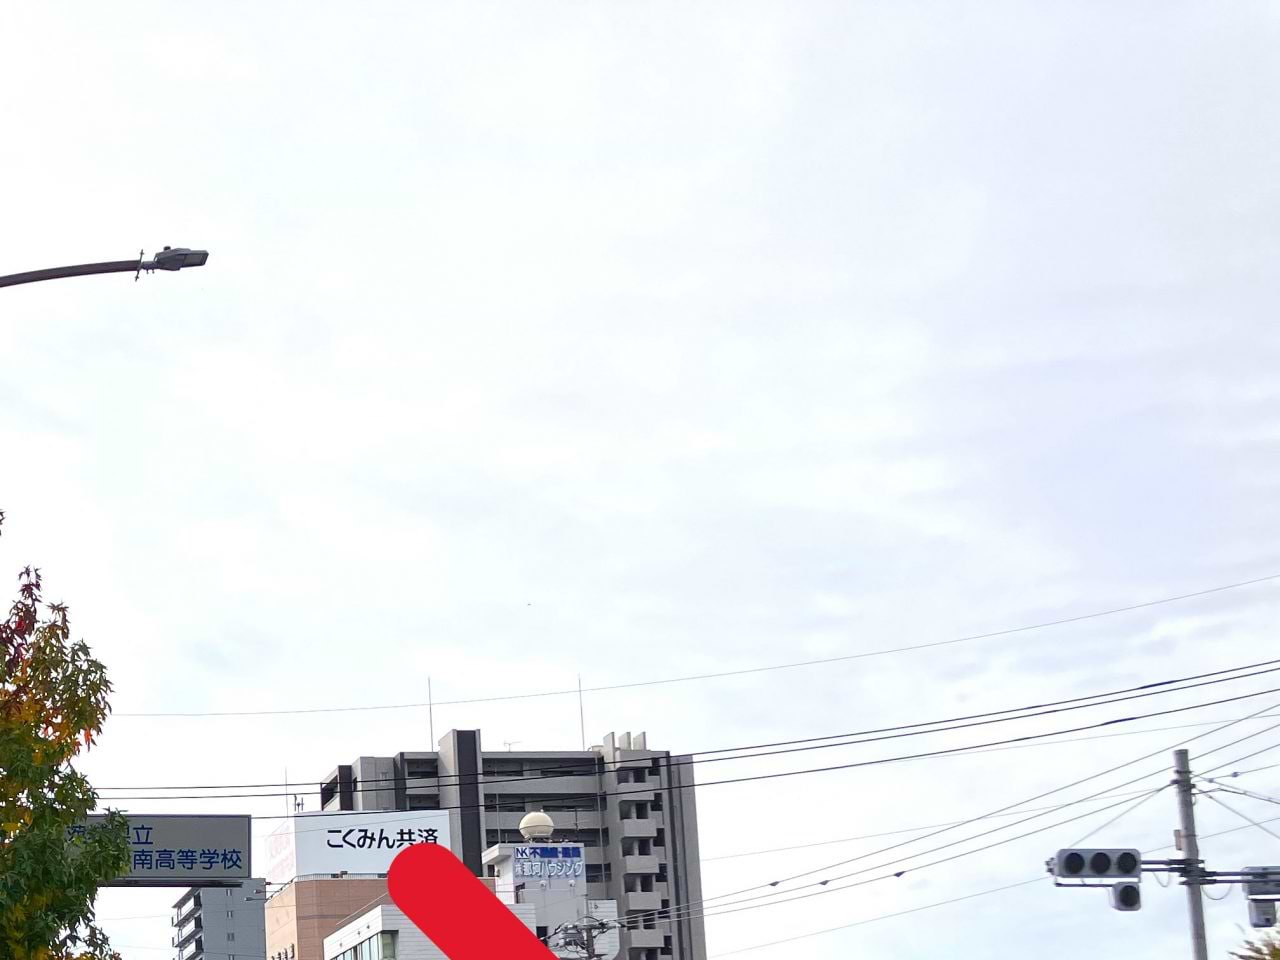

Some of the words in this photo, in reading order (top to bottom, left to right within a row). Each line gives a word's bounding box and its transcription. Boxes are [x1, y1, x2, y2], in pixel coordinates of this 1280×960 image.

[133, 849, 242, 871] 南高等学校
